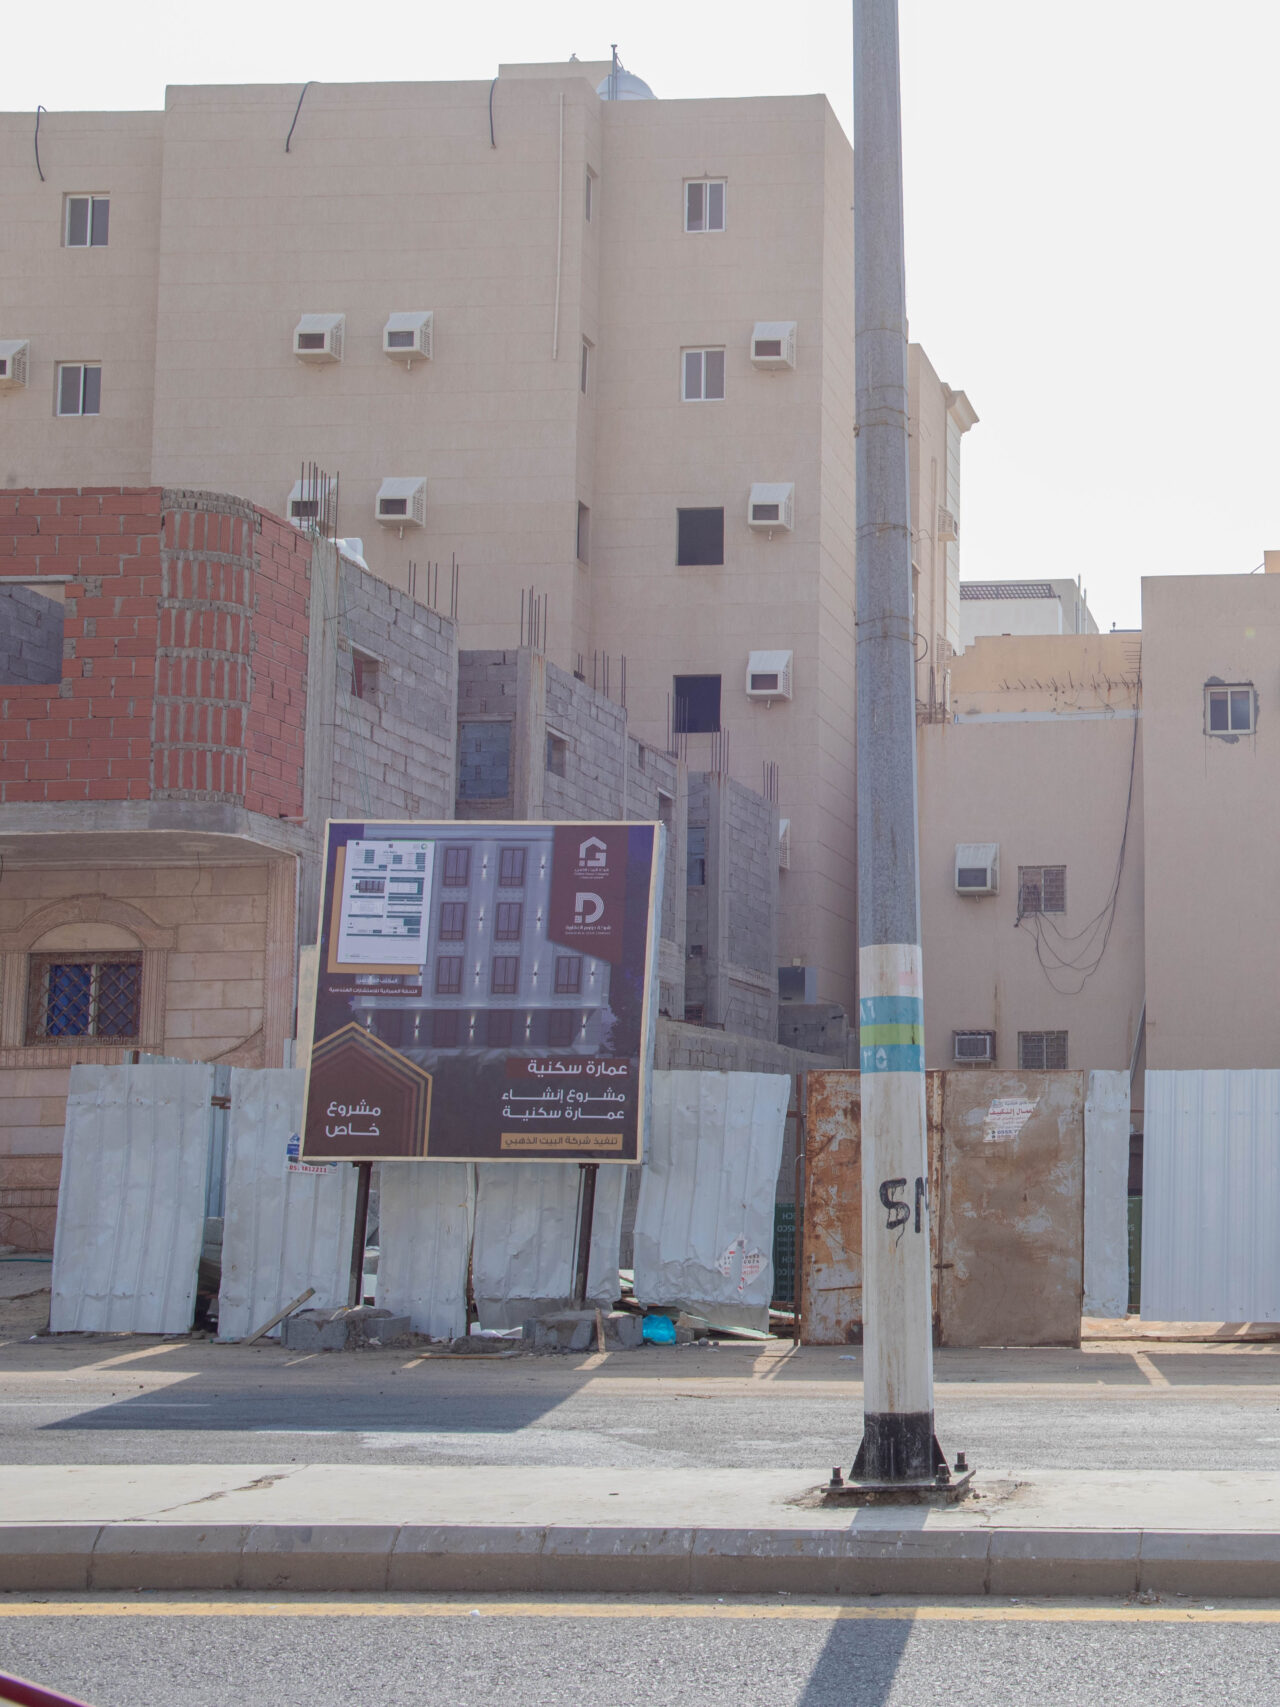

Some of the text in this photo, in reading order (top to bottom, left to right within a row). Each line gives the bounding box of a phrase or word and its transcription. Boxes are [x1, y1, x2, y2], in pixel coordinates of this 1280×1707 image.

[527, 1059, 628, 1078] عمارة سكنية
[501, 1086, 626, 1104] مشروع إنشاء
[326, 1099, 382, 1117] مشروع
[502, 1105, 625, 1122] عمارة سكنية
[325, 1122, 380, 1138] خاص
[504, 1135, 618, 1147] تنفيذ شركة البيت الذهبي
